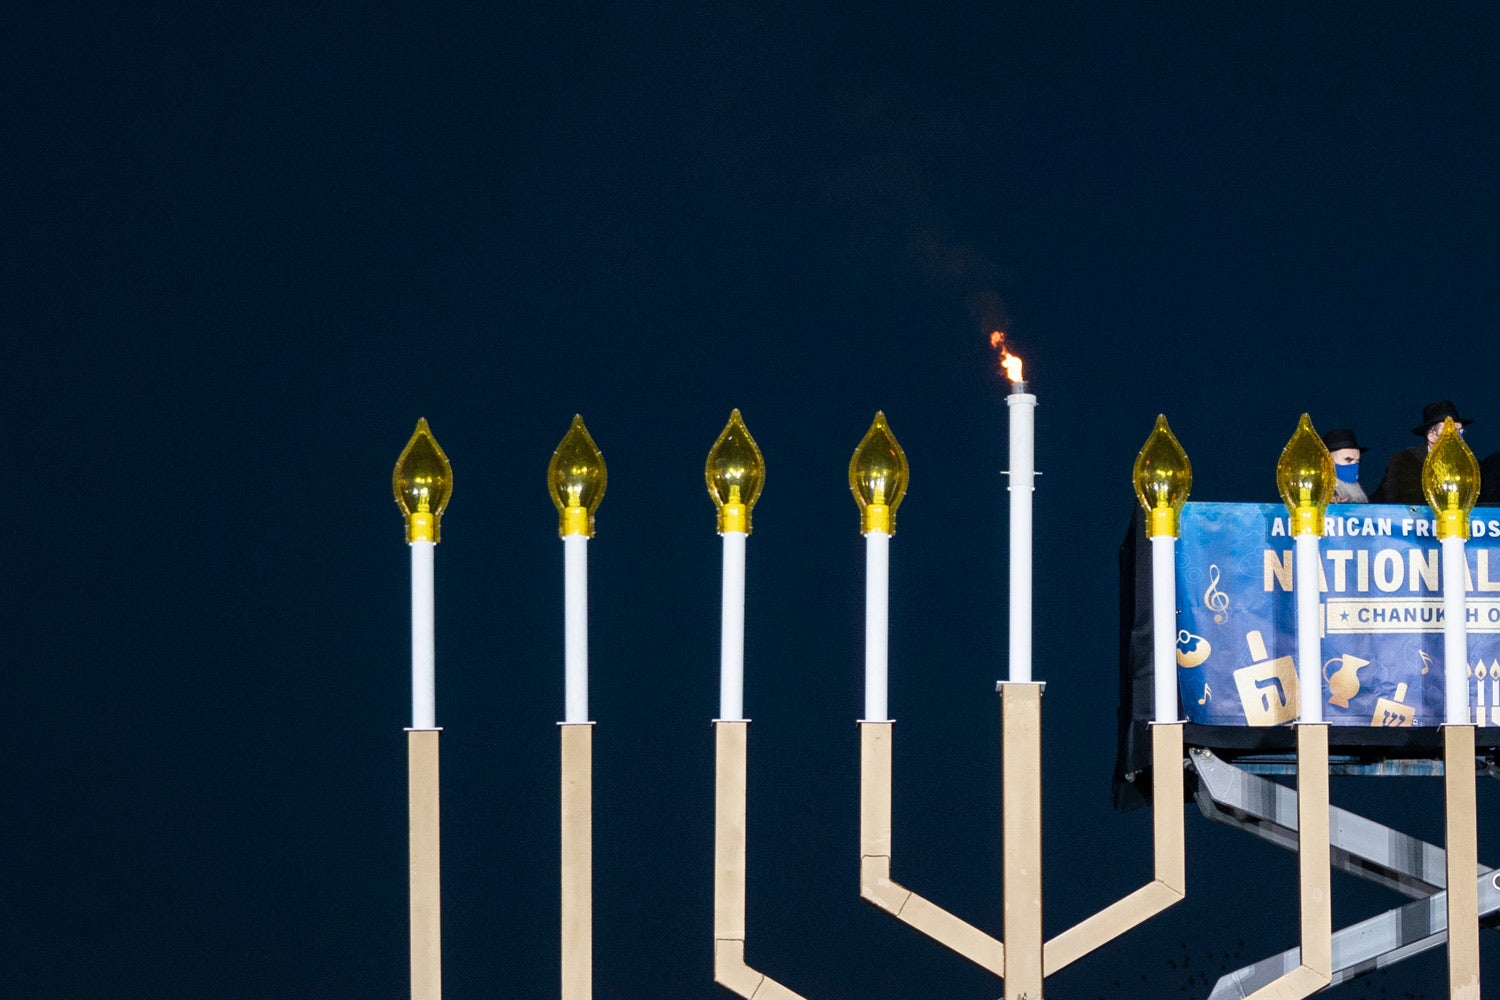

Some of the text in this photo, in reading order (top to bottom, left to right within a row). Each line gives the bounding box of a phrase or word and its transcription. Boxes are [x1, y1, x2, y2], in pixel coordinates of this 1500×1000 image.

[1271, 517, 1392, 537] ARICAN
[1402, 519, 1500, 538] FRIDS
[1357, 607, 1479, 623] CHANUKH
